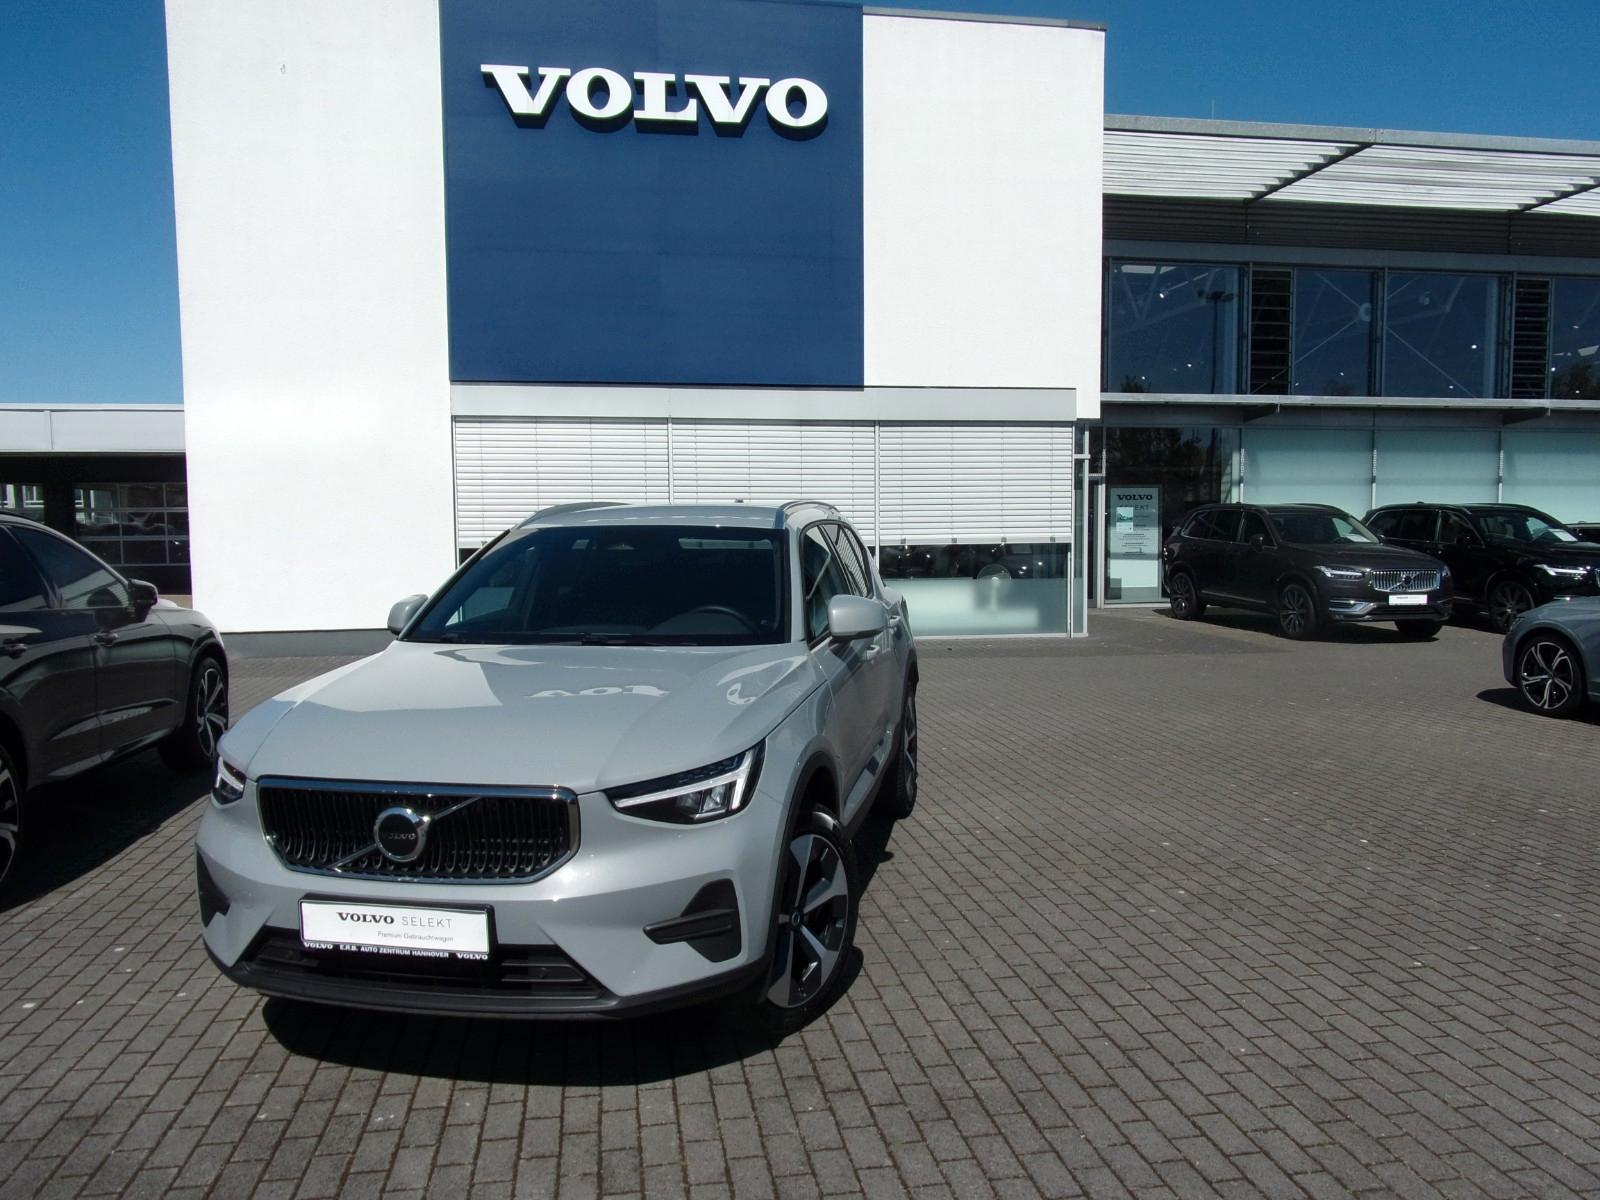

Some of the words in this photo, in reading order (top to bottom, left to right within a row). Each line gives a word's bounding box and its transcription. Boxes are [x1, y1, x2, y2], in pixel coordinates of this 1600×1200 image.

[480, 64, 828, 128] VOLVO
[336, 911, 395, 925] VOLVO
[401, 916, 453, 929] SELEKT
[377, 930, 402, 939] Premium
[403, 932, 454, 943] Gebrauchtwagen
[303, 942, 334, 950] VOLVO
[379, 947, 410, 956] ZENTRUM
[412, 949, 449, 958] HANNOVER
[456, 952, 488, 960] VOLVO
